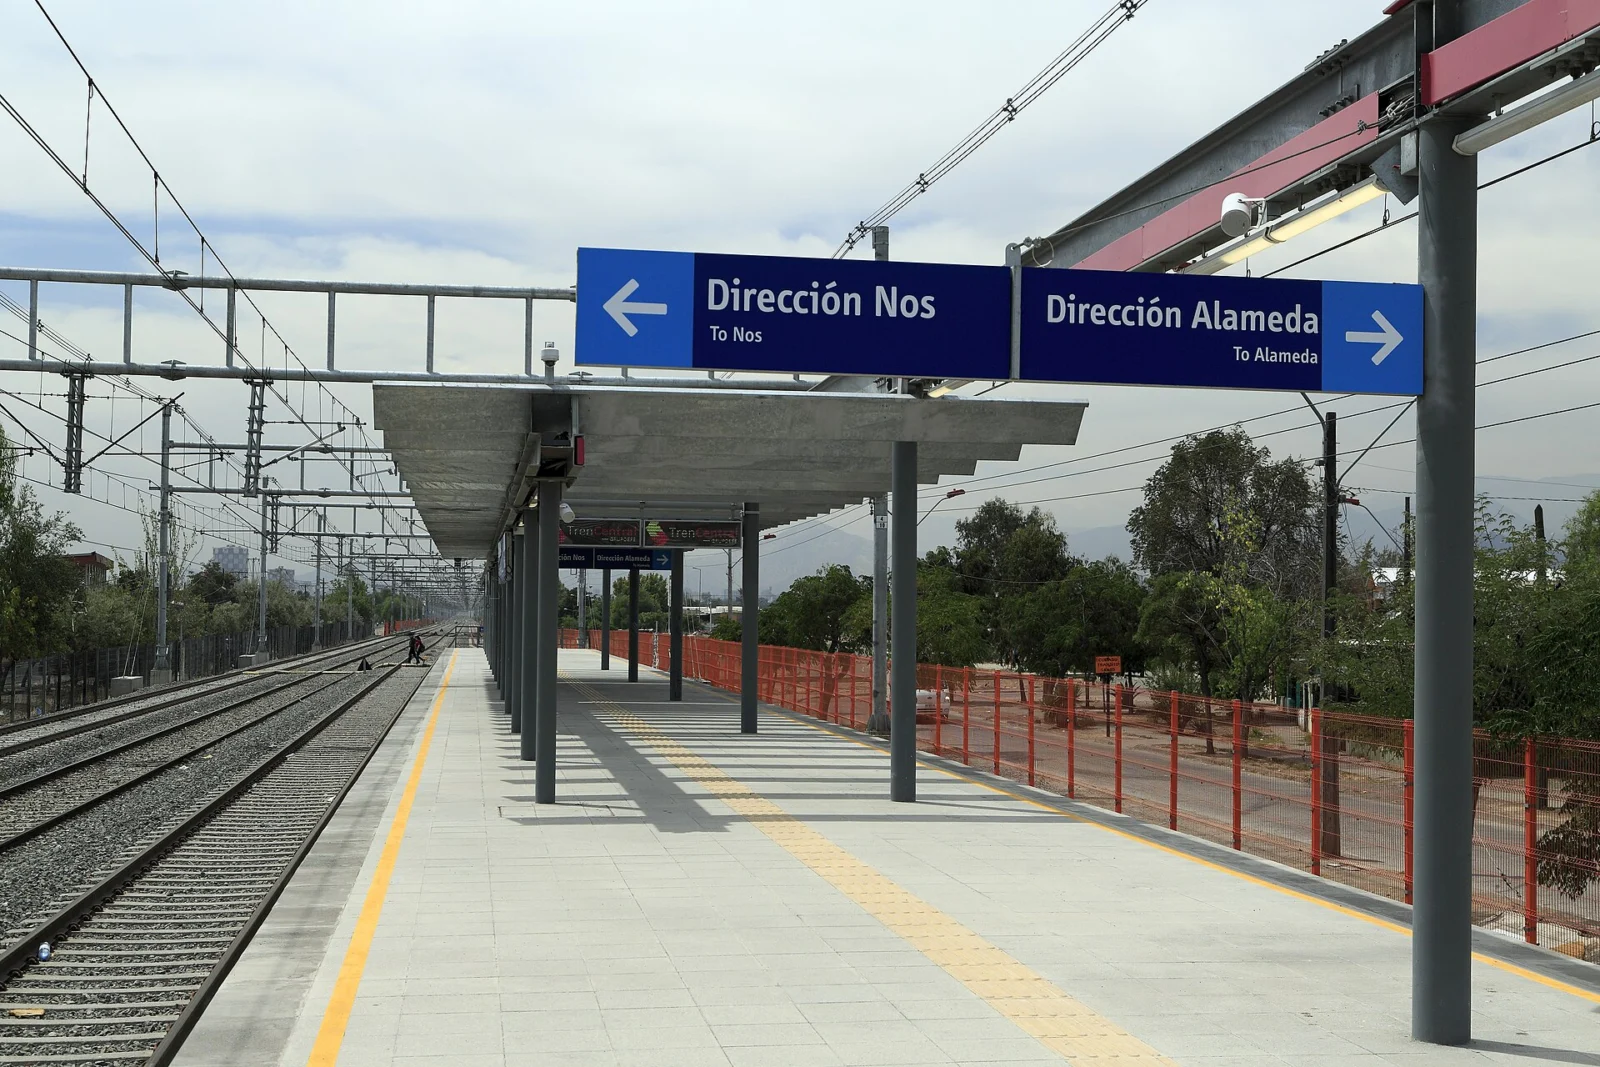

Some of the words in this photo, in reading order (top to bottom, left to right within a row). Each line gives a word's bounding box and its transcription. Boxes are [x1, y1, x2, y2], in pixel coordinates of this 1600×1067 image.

[707, 277, 861, 316] Dirección
[875, 285, 936, 319] Nos
[1047, 293, 1181, 329] Dirección
[1191, 299, 1319, 334] Alameda
[709, 325, 728, 342] To
[733, 326, 763, 343] Nos
[1232, 346, 1250, 362] To
[1254, 346, 1318, 364] Alameda
[567, 524, 638, 536] TrenCentral
